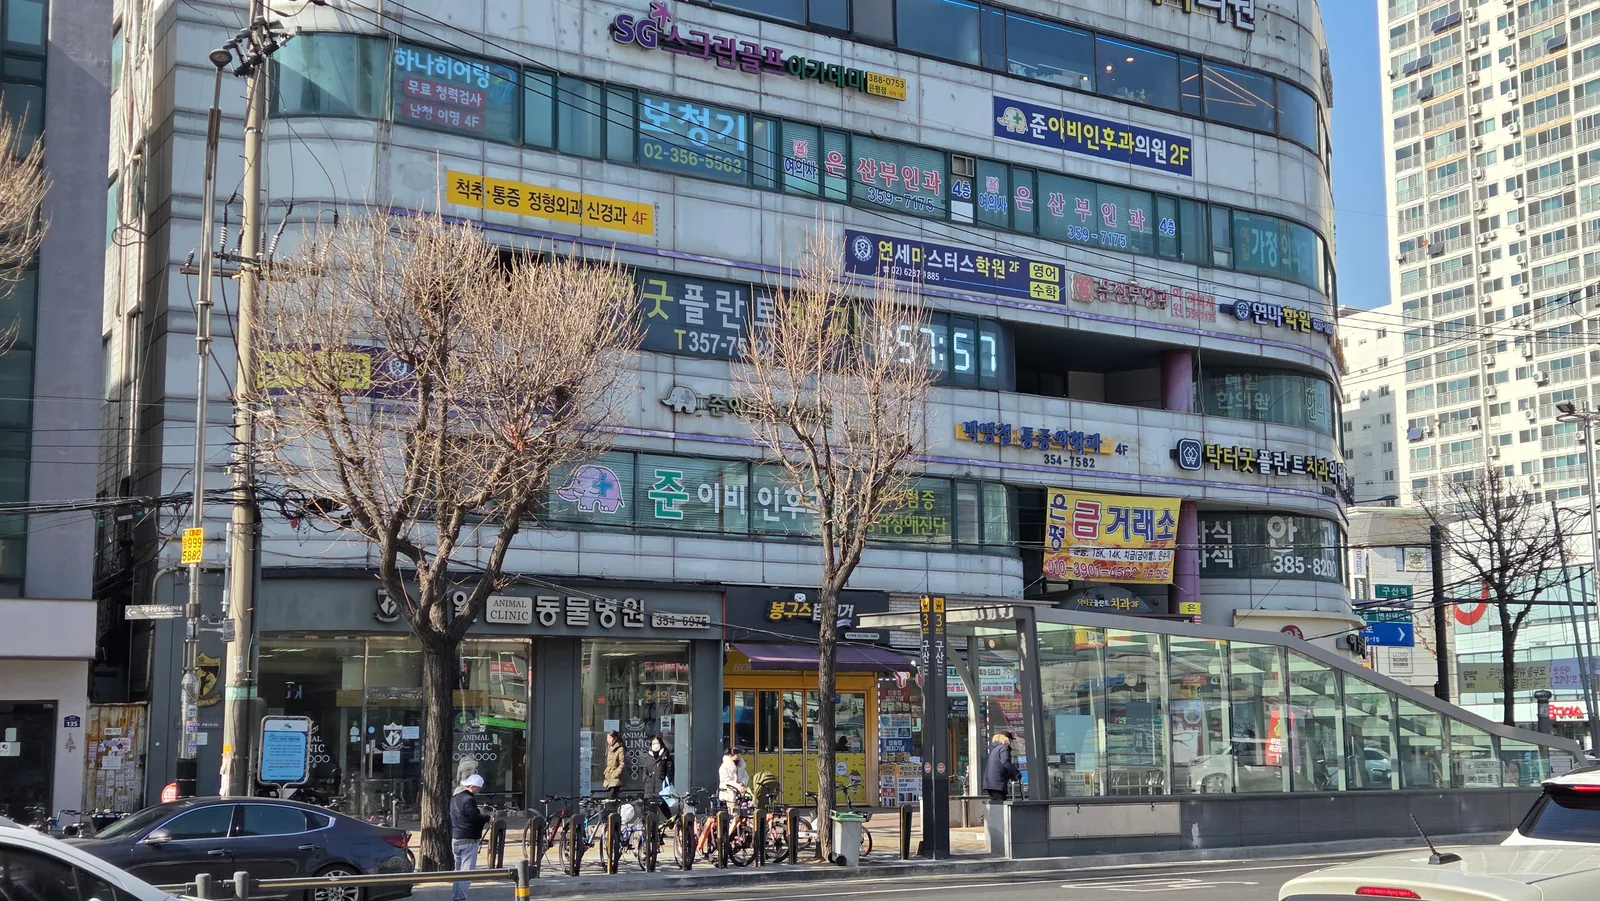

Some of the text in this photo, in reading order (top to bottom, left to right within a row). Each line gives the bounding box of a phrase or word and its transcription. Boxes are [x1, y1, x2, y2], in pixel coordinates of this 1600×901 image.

[614, 14, 658, 48] SG
[394, 48, 490, 89] 하나히어링
[869, 74, 904, 88] 388-0753
[407, 80, 482, 107] 무료 청력검사
[410, 103, 480, 128] 난청 이명 4F
[639, 98, 746, 152] 보청기
[643, 142, 742, 175] 02-356-5563
[1170, 144, 1190, 167] 2F
[784, 150, 973, 199] 여의사 은 산부인과 4층
[527, 190, 583, 218] 정형외과
[587, 202, 628, 225] 신경과
[632, 210, 648, 226] 4F
[977, 191, 1008, 215] 여의사
[1014, 185, 1034, 212] 은
[1159, 218, 1176, 236] 4층
[1008, 260, 1020, 274] 2F
[1032, 264, 1058, 280] 영어
[1032, 284, 1058, 300] 수학
[1252, 301, 1312, 334] 연마학원
[1020, 426, 1103, 456] 통증의학과
[1115, 443, 1128, 456] 4F
[1047, 558, 1138, 580] 010-3901-4562
[1272, 554, 1337, 578] 385-8200
[490, 609, 529, 621] CLINIC
[493, 600, 527, 610] ANIMAL
[535, 595, 645, 629] 동물병원
[922, 613, 929, 627] 3
[935, 613, 943, 627] 3
[922, 640, 930, 665] 구산
[935, 640, 944, 665] 구산
[457, 742, 493, 751] CLINIC
